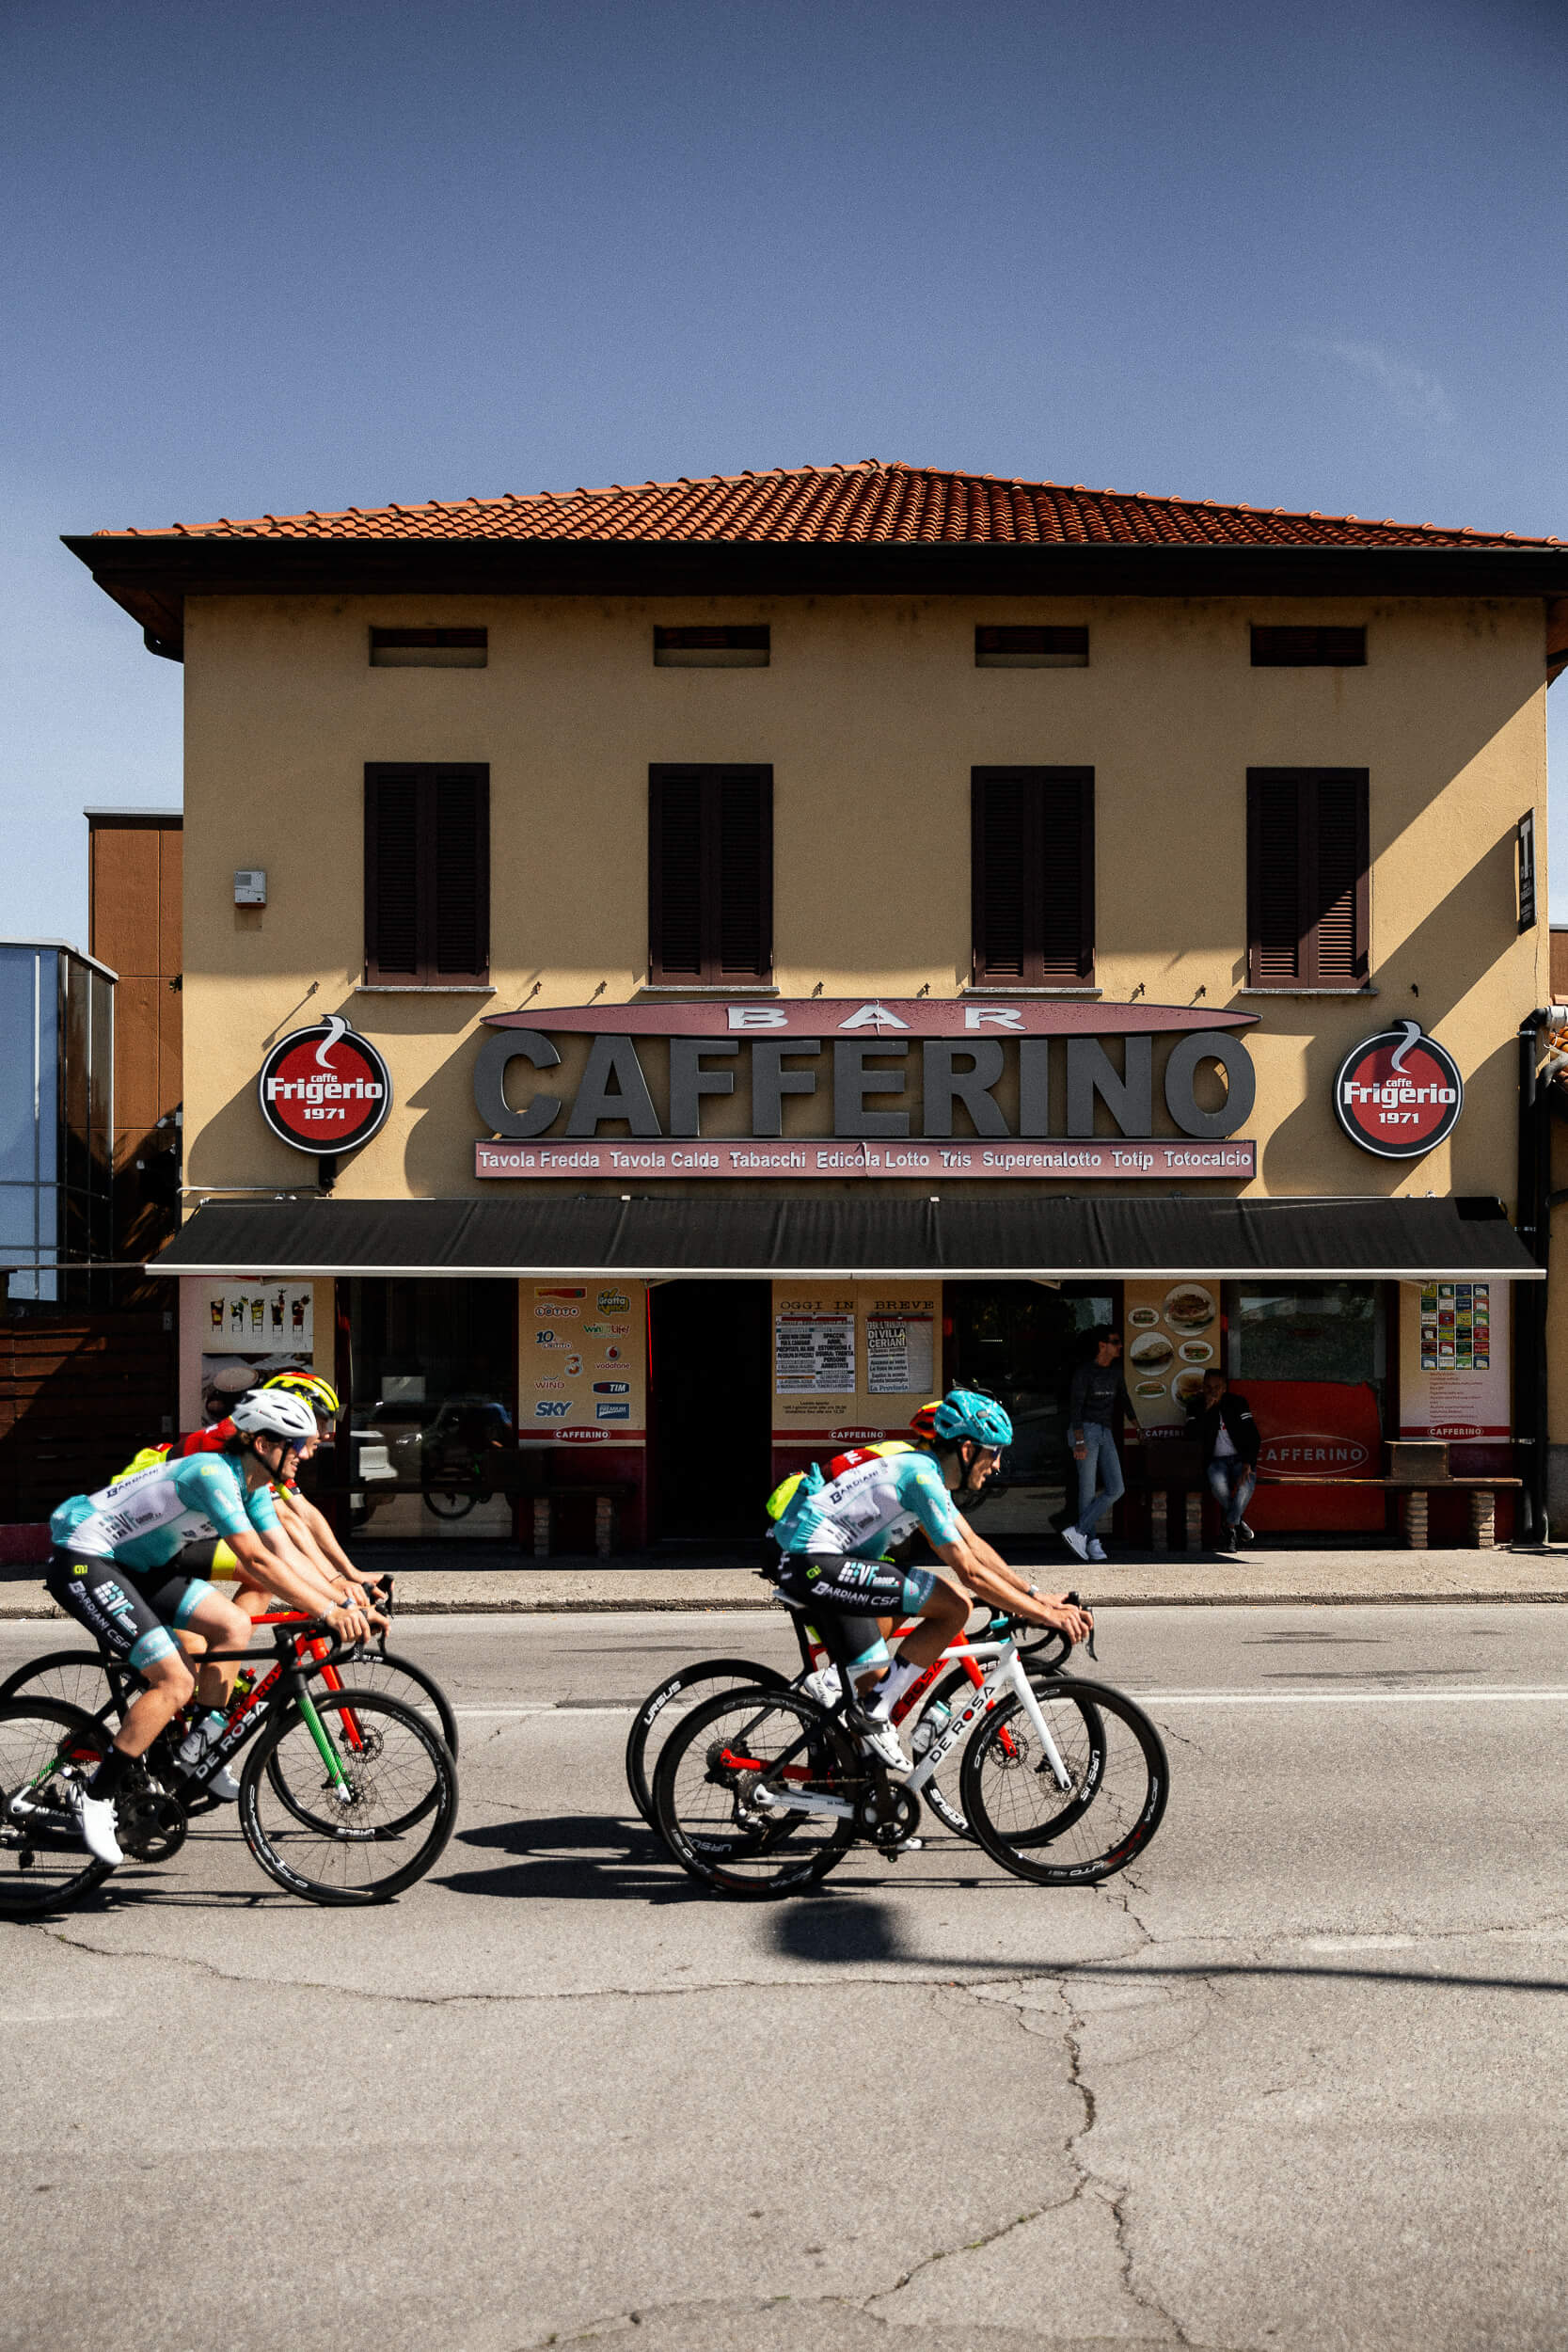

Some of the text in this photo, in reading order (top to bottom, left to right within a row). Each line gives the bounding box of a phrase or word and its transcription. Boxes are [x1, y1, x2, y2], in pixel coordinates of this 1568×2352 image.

[727, 1004, 1027, 1030] BAR
[267, 1077, 383, 1104] Frigerio
[473, 1030, 1257, 1137] CAFFERINO
[1343, 1082, 1456, 1109] Frigerio
[303, 1108, 345, 1120] 1971
[1378, 1112, 1419, 1124] 1971
[479, 1151, 1251, 1171] Tavola Fredda Tavola Calda Tabacchi Edicola Lotto Tris Superenalotto Totip Totocalcio
[535, 1306, 579, 1317] LOTTO
[780, 1300, 934, 1310] OGGI IN BREVE
[535, 1330, 554, 1343] 10
[868, 1328, 906, 1339] DI VILLA
[868, 1338, 906, 1348] CERIANI
[610, 1384, 626, 1392] TIM
[535, 1401, 572, 1417] SKY
[811, 1581, 900, 1607] BARDIANI CSF
[68, 1581, 111, 1630] BARDIANI
[107, 1629, 132, 1649] CSF
[643, 1680, 682, 1726] URSUS
[929, 1737, 952, 1764] DE
[951, 1685, 996, 1736] ROSA
[196, 1752, 220, 1779] DE
[220, 1701, 271, 1751] ROSA
[1080, 1749, 1101, 1802] URSUS
[929, 1788, 969, 1830] URSUS
